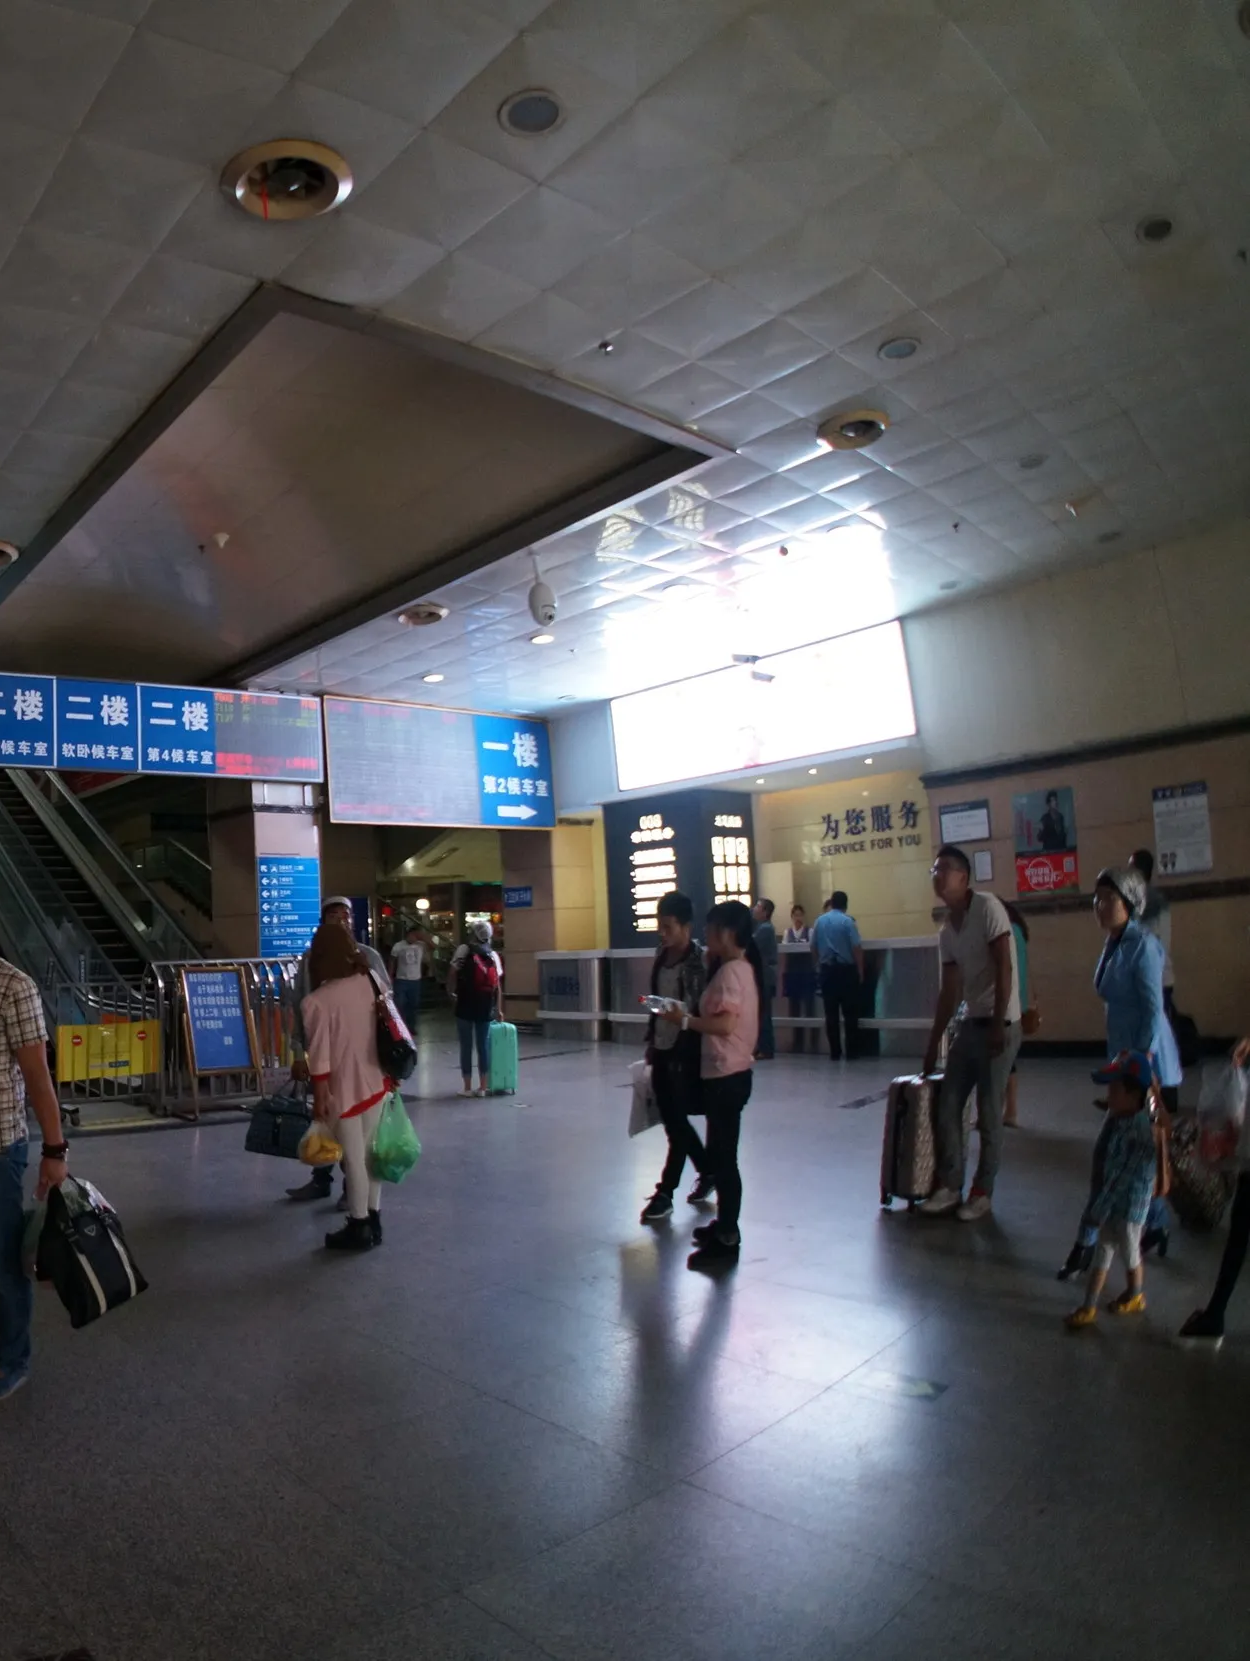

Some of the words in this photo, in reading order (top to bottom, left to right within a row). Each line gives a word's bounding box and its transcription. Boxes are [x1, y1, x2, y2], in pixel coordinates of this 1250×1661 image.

[65, 693, 129, 727] 二楼
[149, 700, 209, 731] 二楼
[61, 743, 134, 762] 软卧候车室
[147, 747, 214, 765] 第4候车室
[482, 732, 539, 768] 一楼
[482, 775, 548, 797] 第2候车室
[820, 800, 919, 841] 为您服务
[821, 840, 866, 857] SERVICE
[870, 837, 893, 850] FOR
[897, 834, 922, 848] YOU
